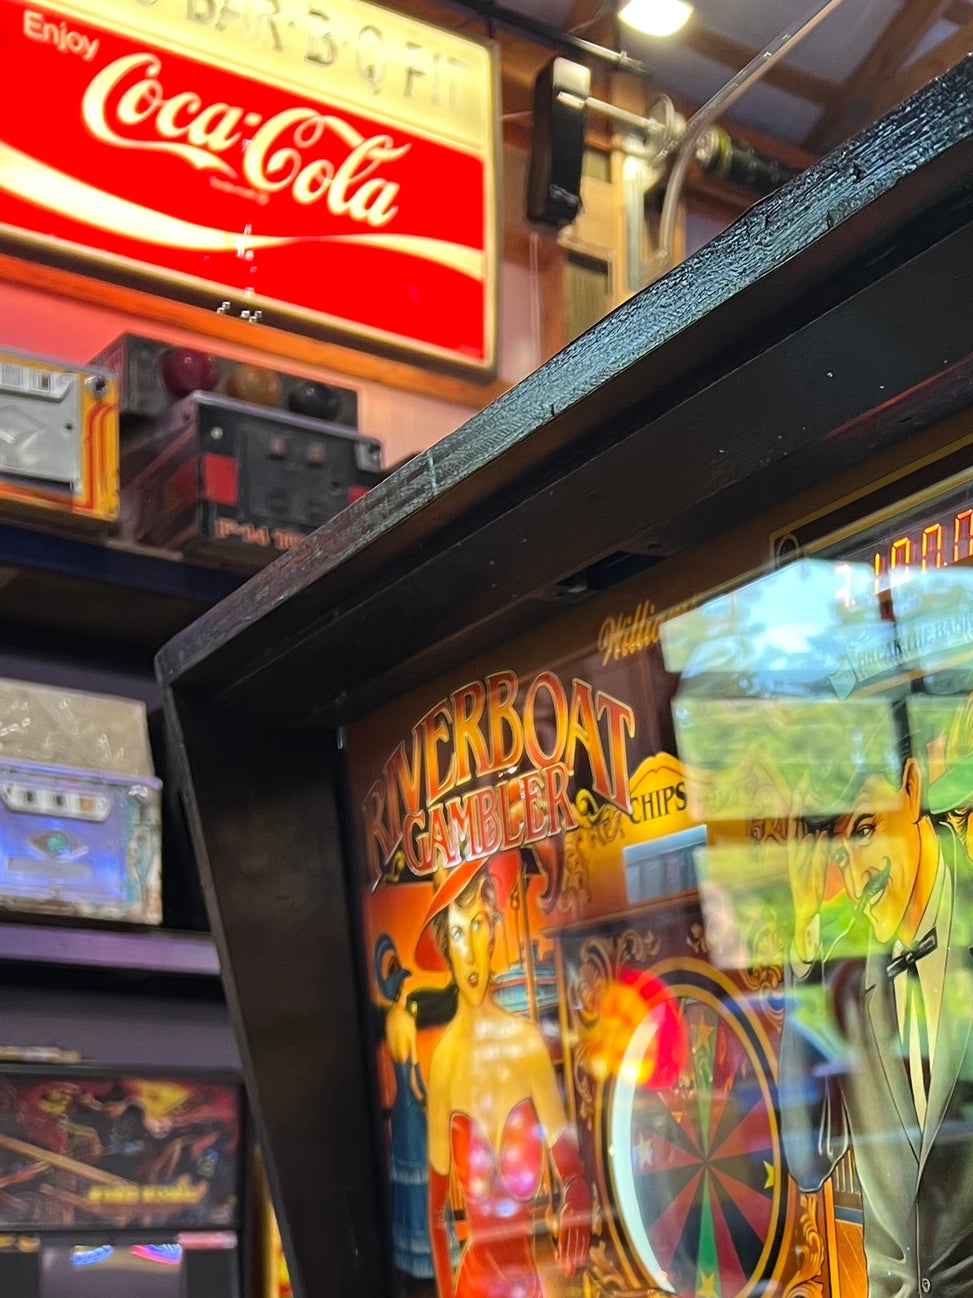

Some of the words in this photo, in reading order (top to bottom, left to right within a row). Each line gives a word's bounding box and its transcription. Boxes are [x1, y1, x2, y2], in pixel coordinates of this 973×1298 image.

[24, 10, 99, 61] Enjoy
[82, 52, 411, 227] Coca-Cola
[362, 669, 635, 893] RIVERBOAT
[402, 762, 578, 877] GAMBLER
[630, 781, 688, 825] CHIPS
